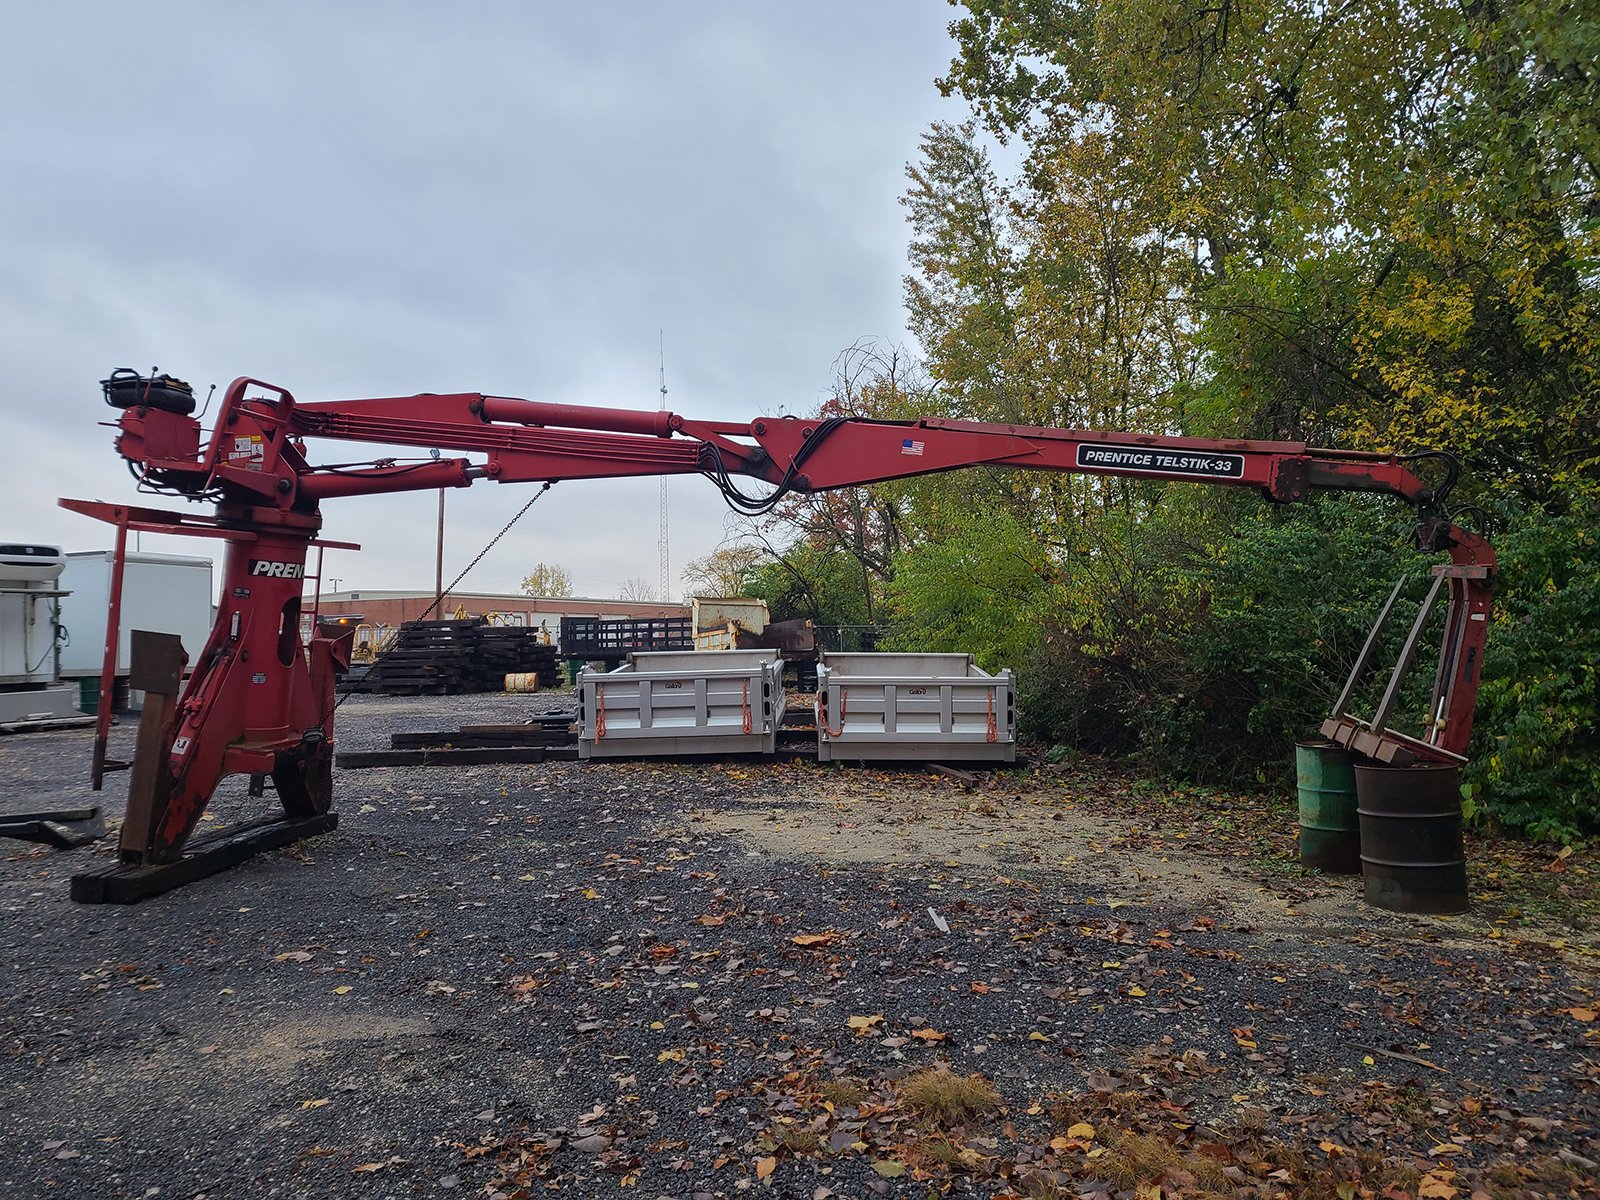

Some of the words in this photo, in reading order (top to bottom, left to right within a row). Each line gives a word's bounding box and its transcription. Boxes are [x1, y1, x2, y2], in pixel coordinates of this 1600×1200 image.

[1085, 450, 1153, 466] PRENTICE
[1155, 455, 1233, 472] TELSTIK-33
[252, 560, 305, 579] PREN
